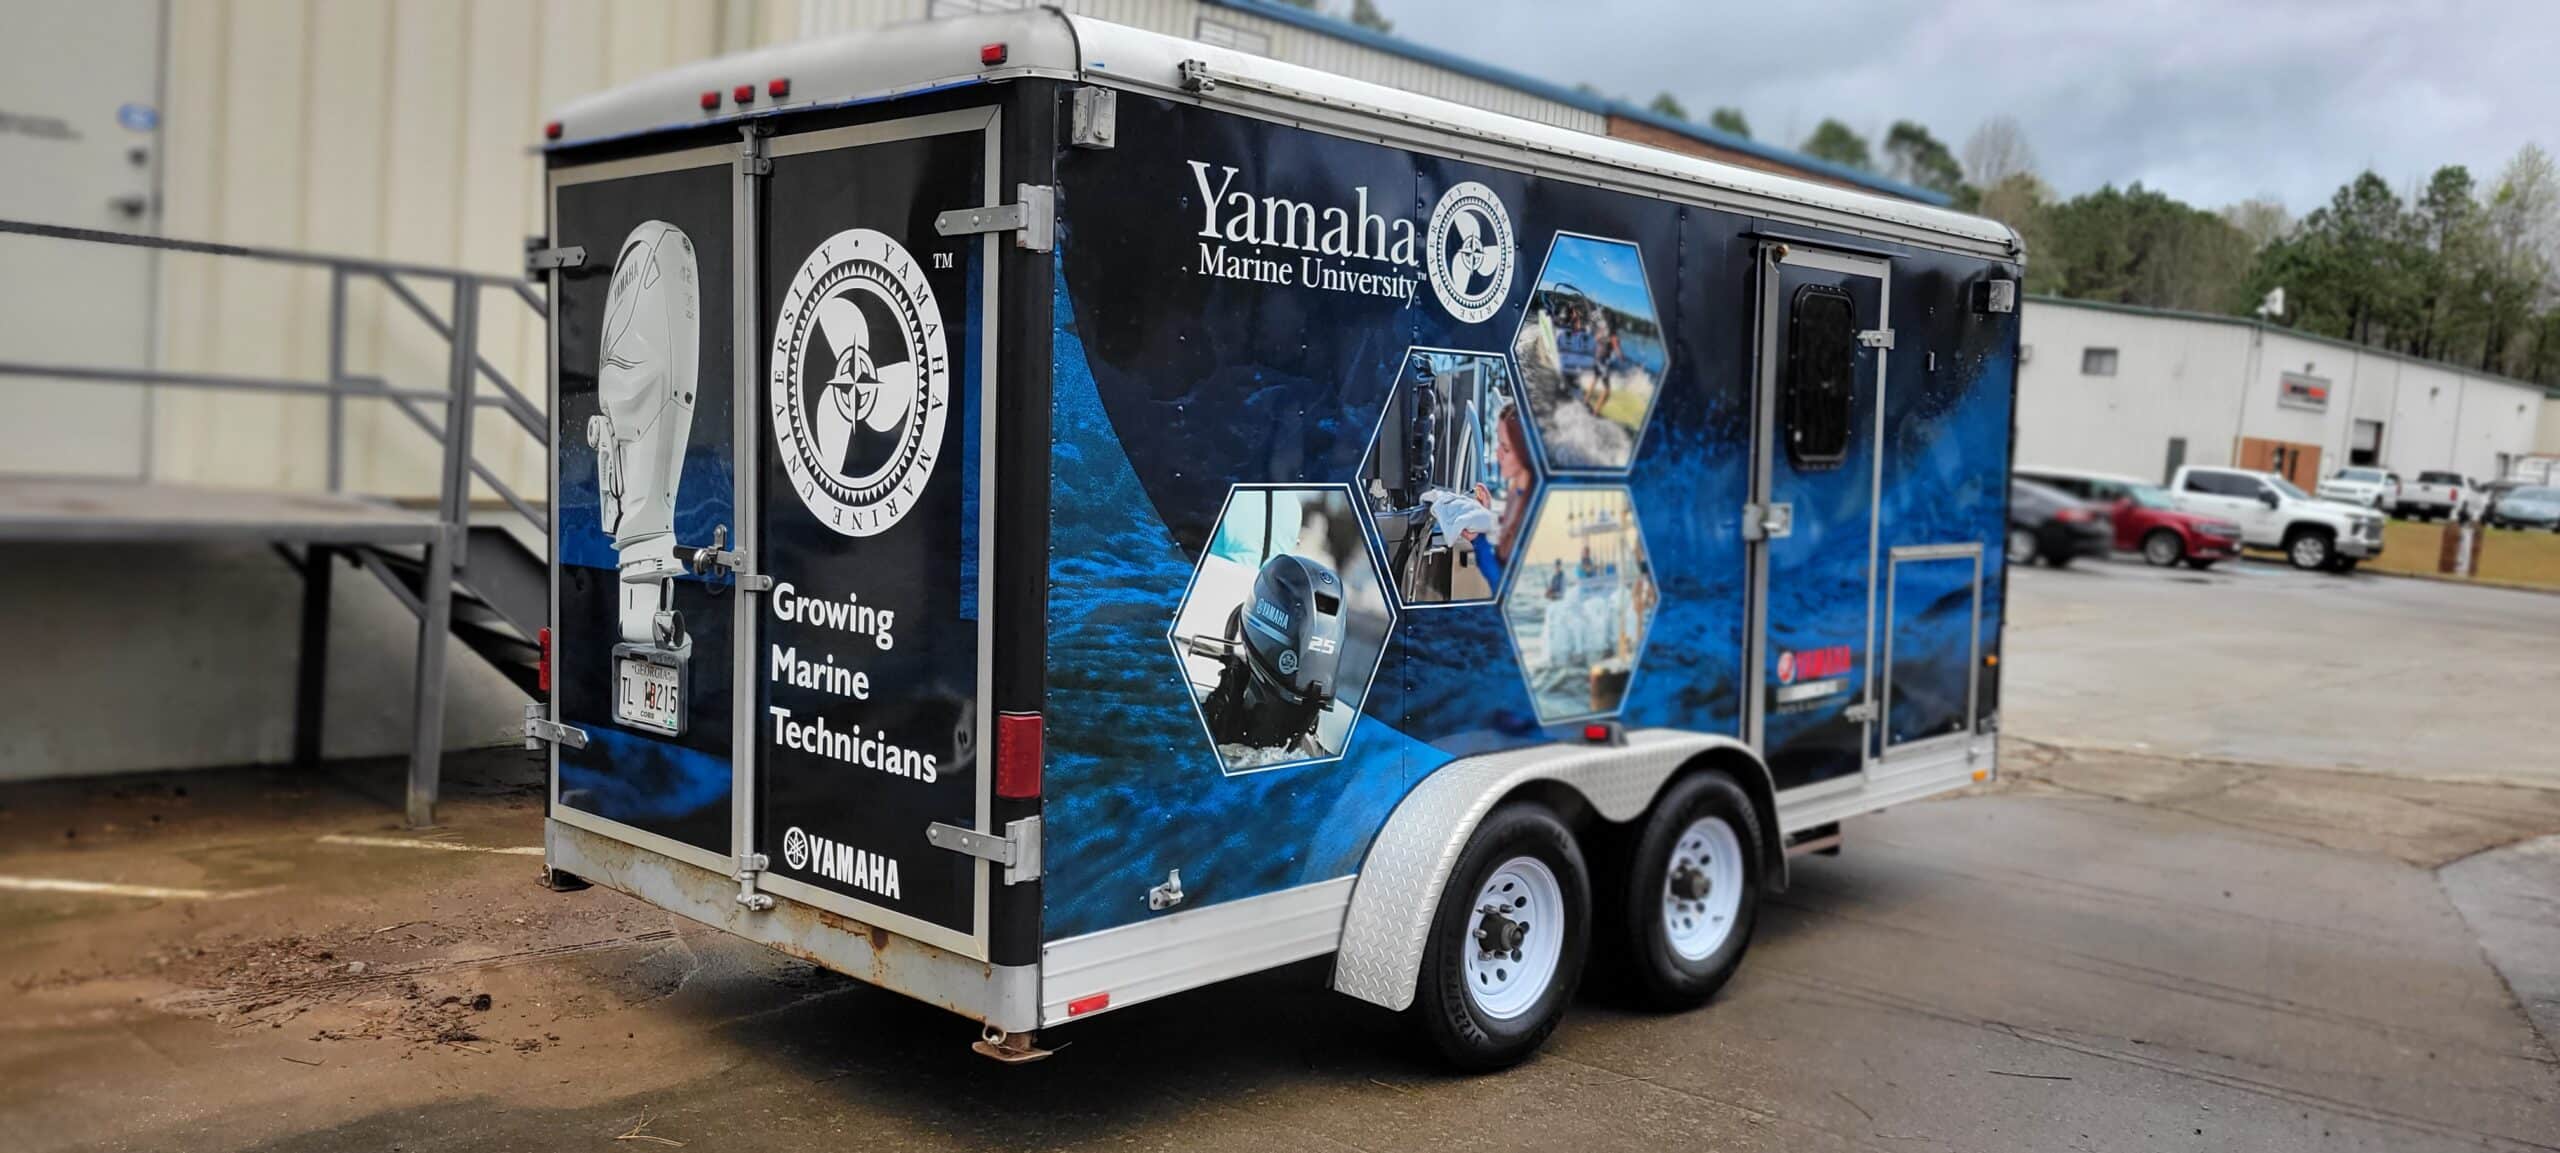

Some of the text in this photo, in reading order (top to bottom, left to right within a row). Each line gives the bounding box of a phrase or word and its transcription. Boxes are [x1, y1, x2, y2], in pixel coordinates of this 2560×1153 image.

[1187, 160, 1419, 267] Yamaha
[614, 261, 639, 305] YAMAHA
[933, 252, 953, 269] TM
[1198, 242, 1293, 285] Marine
[1301, 256, 1418, 310] University
[775, 242, 945, 531] YAMAHA MARINE UNIVERSITY
[772, 582, 894, 650] Growing
[1262, 600, 1289, 630] YAMAHA
[1308, 635, 1336, 655] 25
[771, 643, 870, 700] Marine
[769, 705, 937, 784] Technicians
[809, 834, 900, 900] YAMAHA
